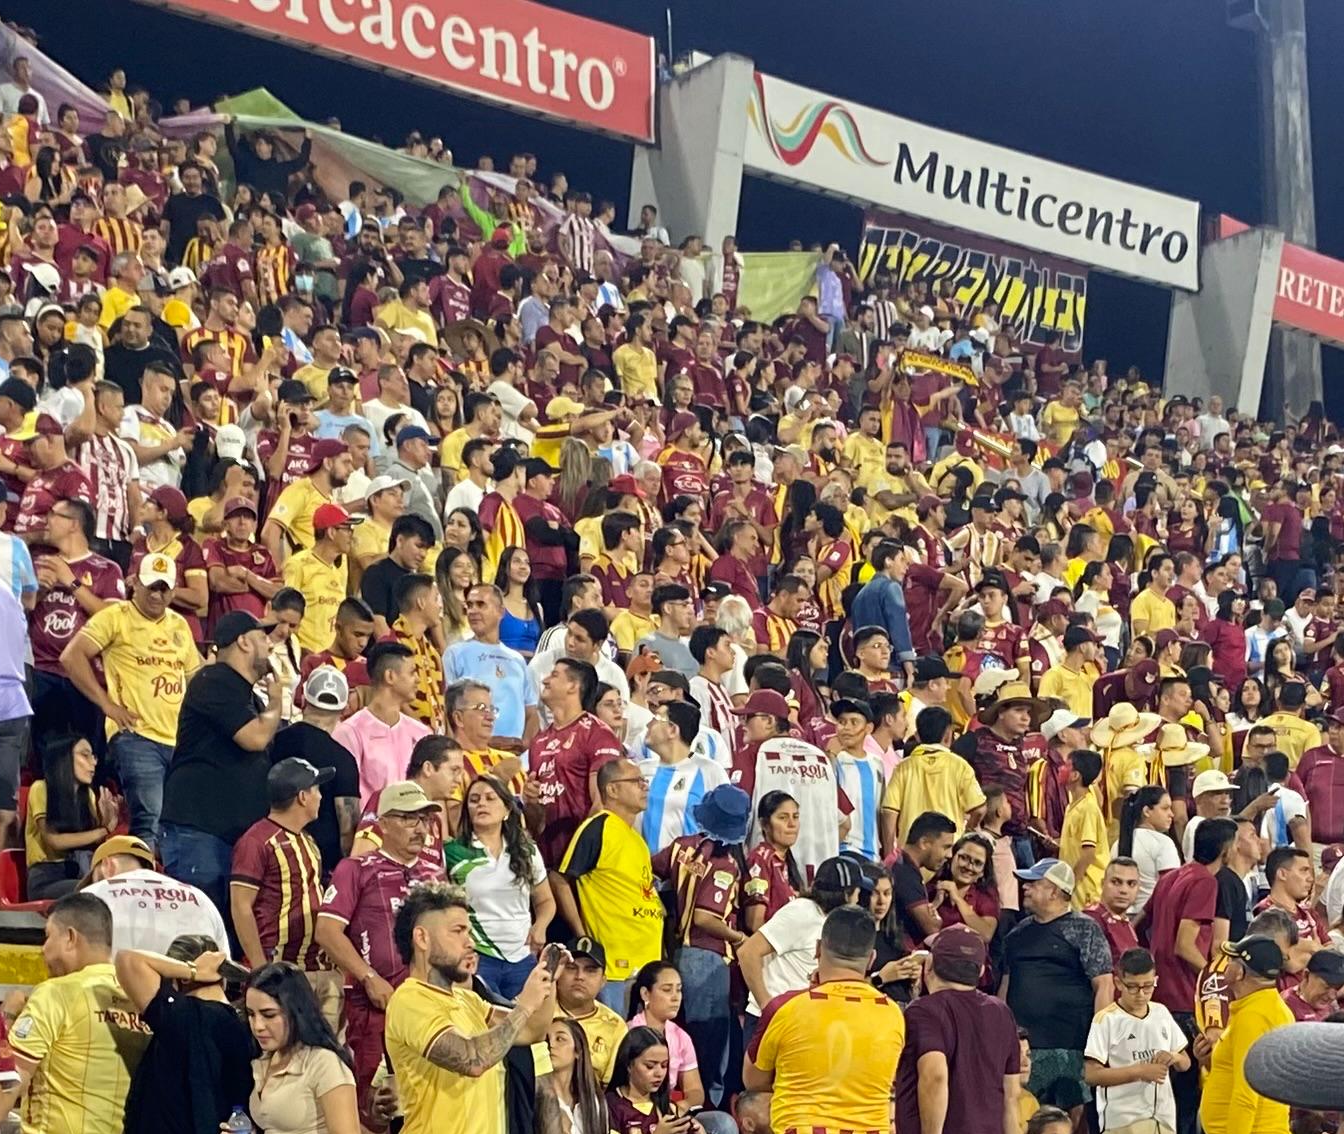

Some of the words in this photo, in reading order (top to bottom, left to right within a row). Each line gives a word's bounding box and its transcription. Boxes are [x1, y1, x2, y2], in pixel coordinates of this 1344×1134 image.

[892, 142, 1190, 264] Multicentro
[43, 611, 78, 634] Pool
[151, 672, 183, 698] Pool
[768, 764, 800, 775] TAPA
[800, 764, 830, 781] ROJA
[109, 887, 153, 900] TAPA
[154, 887, 200, 909] ROJA
[138, 901, 180, 911] ORO
[94, 1010, 128, 1029] TAPA
